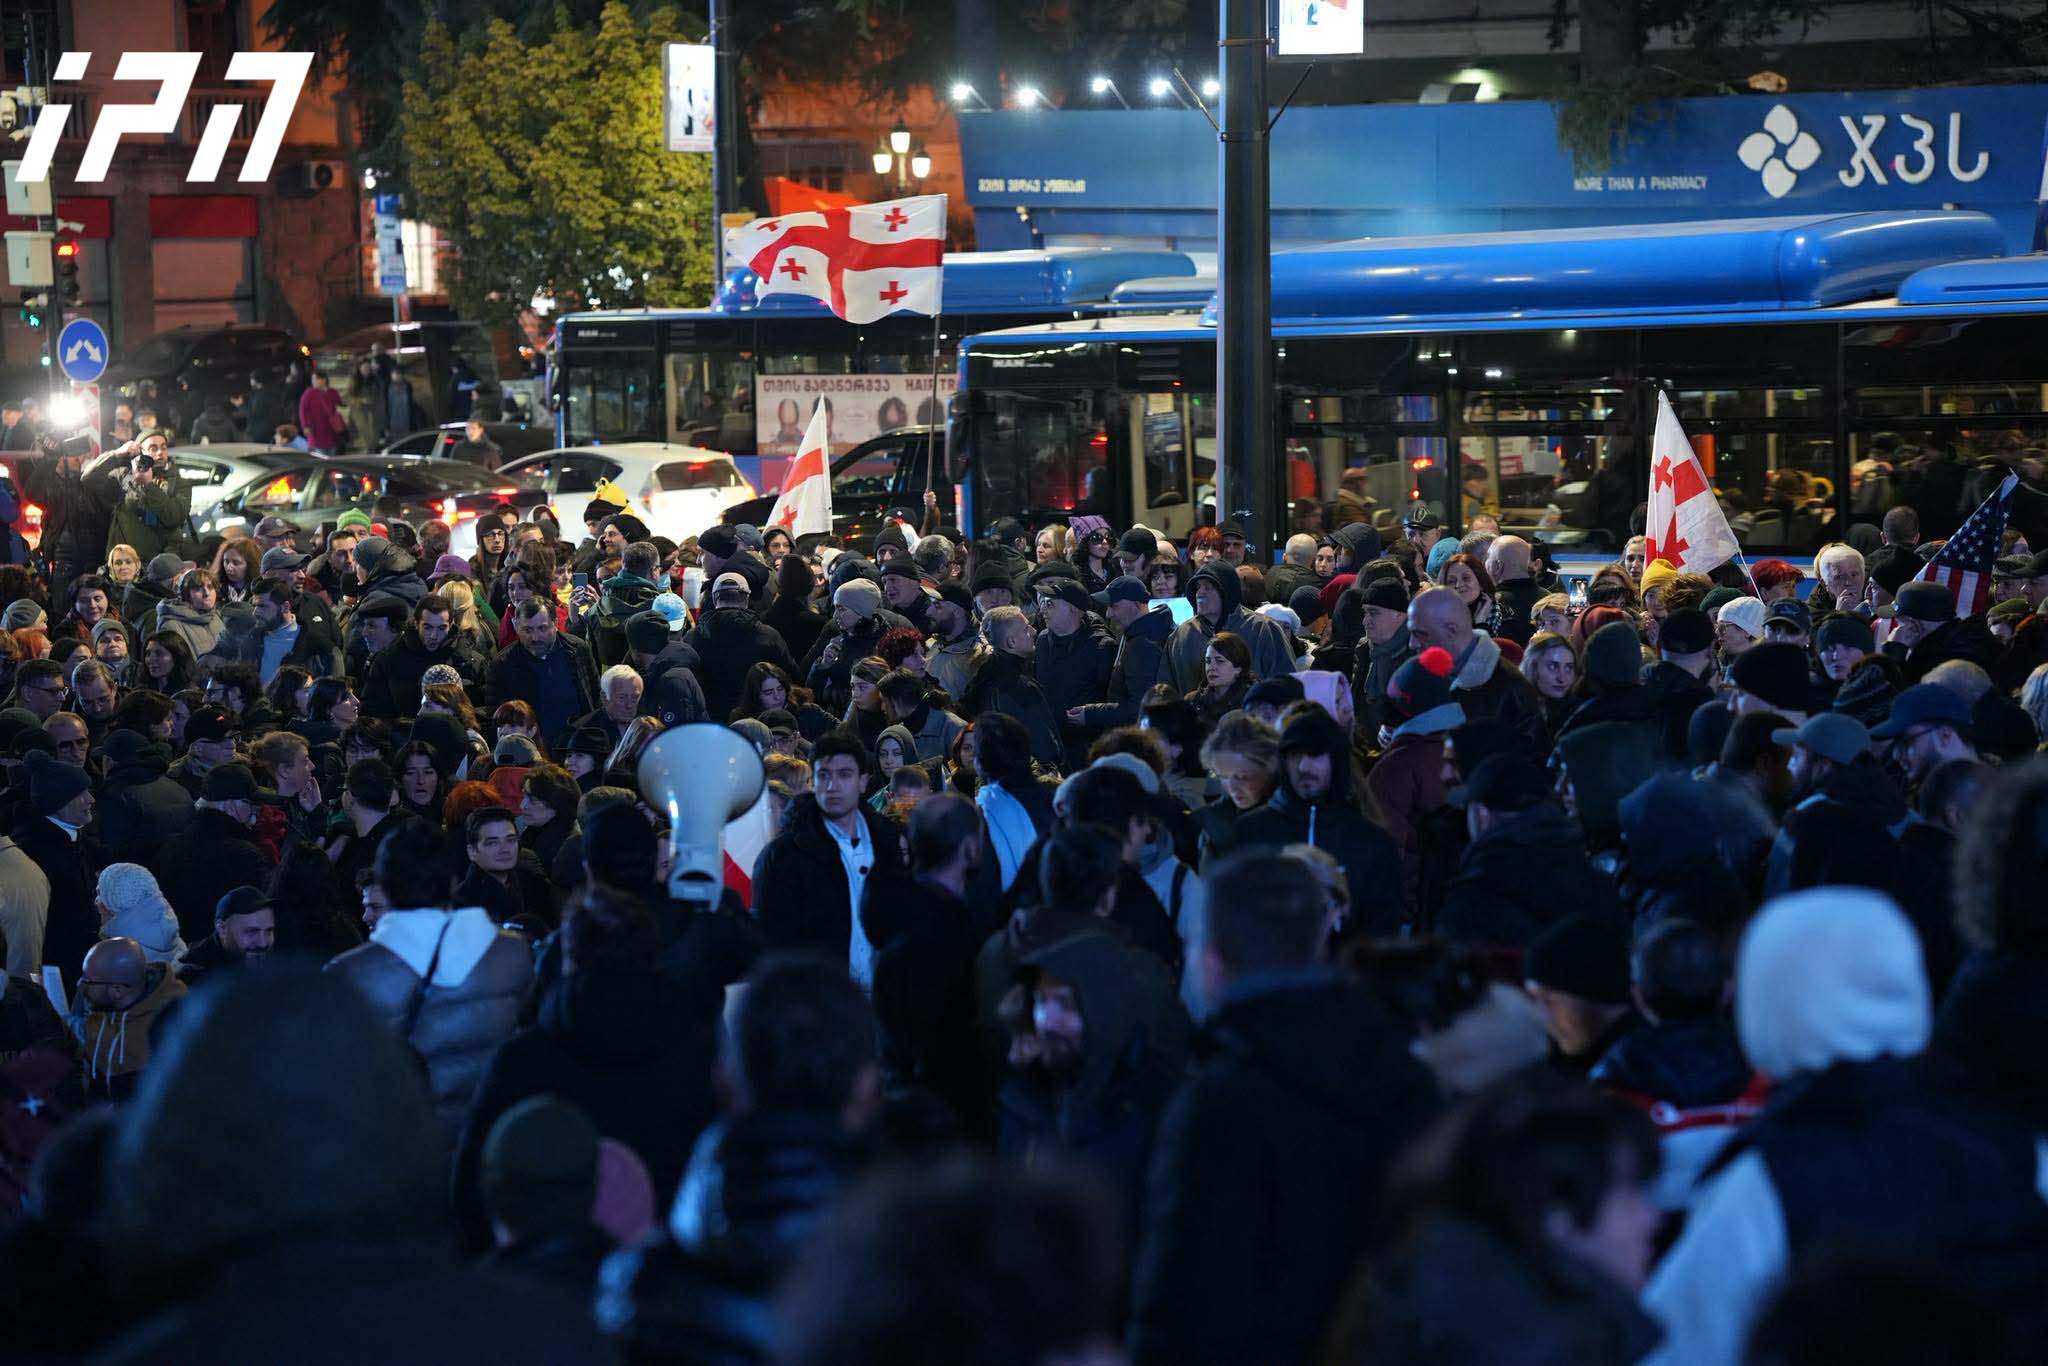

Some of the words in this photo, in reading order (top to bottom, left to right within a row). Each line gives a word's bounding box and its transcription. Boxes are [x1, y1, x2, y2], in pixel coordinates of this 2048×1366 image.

[1573, 177, 1603, 191] MORE
[1608, 177, 1634, 191] THAN
[1639, 177, 1646, 191] A
[1651, 176, 1707, 190] PHARMACY
